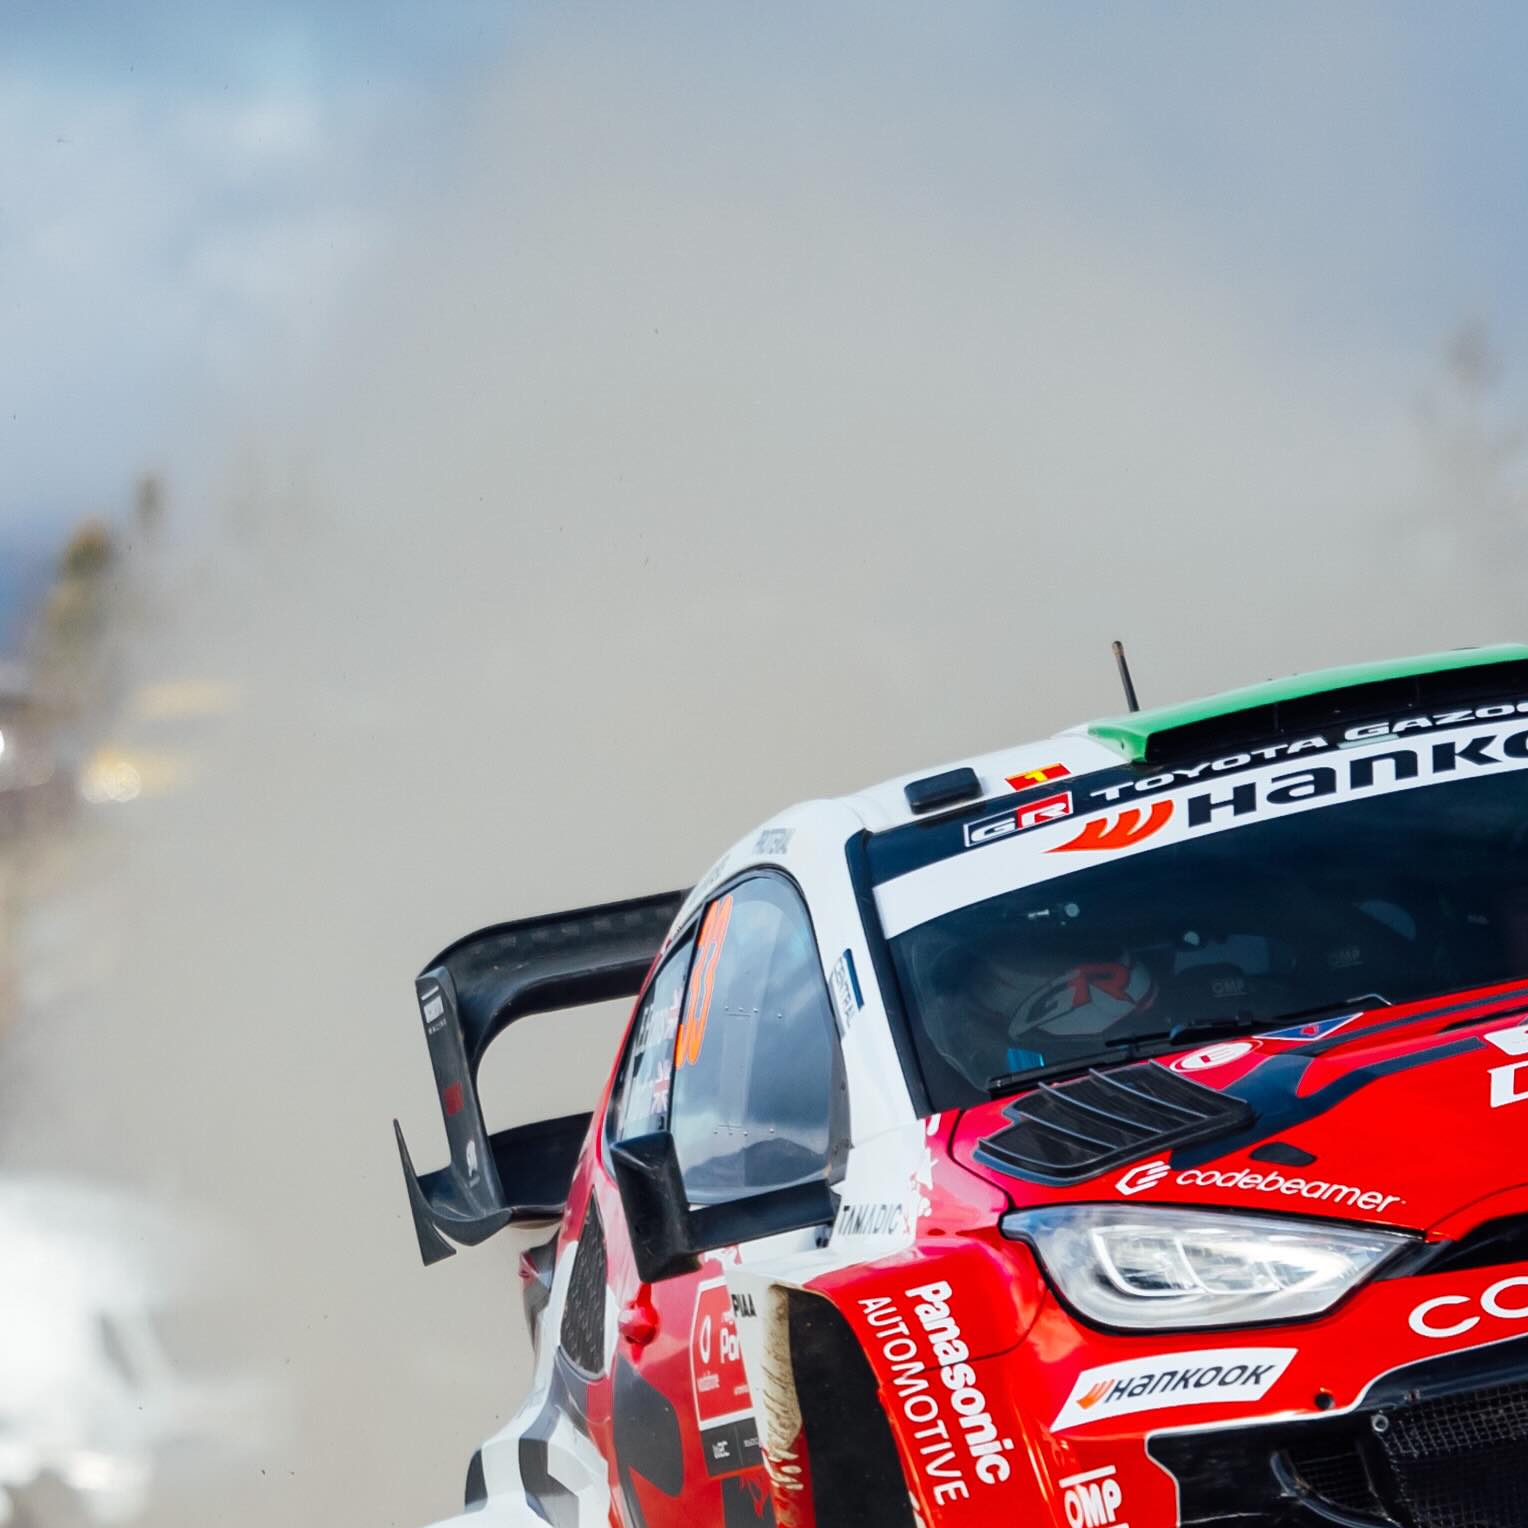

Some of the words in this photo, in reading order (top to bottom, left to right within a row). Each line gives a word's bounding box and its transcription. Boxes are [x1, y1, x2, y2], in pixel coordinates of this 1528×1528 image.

[1090, 736, 1328, 800] TOYOTA
[969, 795, 1070, 843] GR
[1176, 1168, 1400, 1213] codebeamer
[857, 1294, 969, 1507] AUTOMOTIVE
[905, 1280, 1012, 1485] Panasonic
